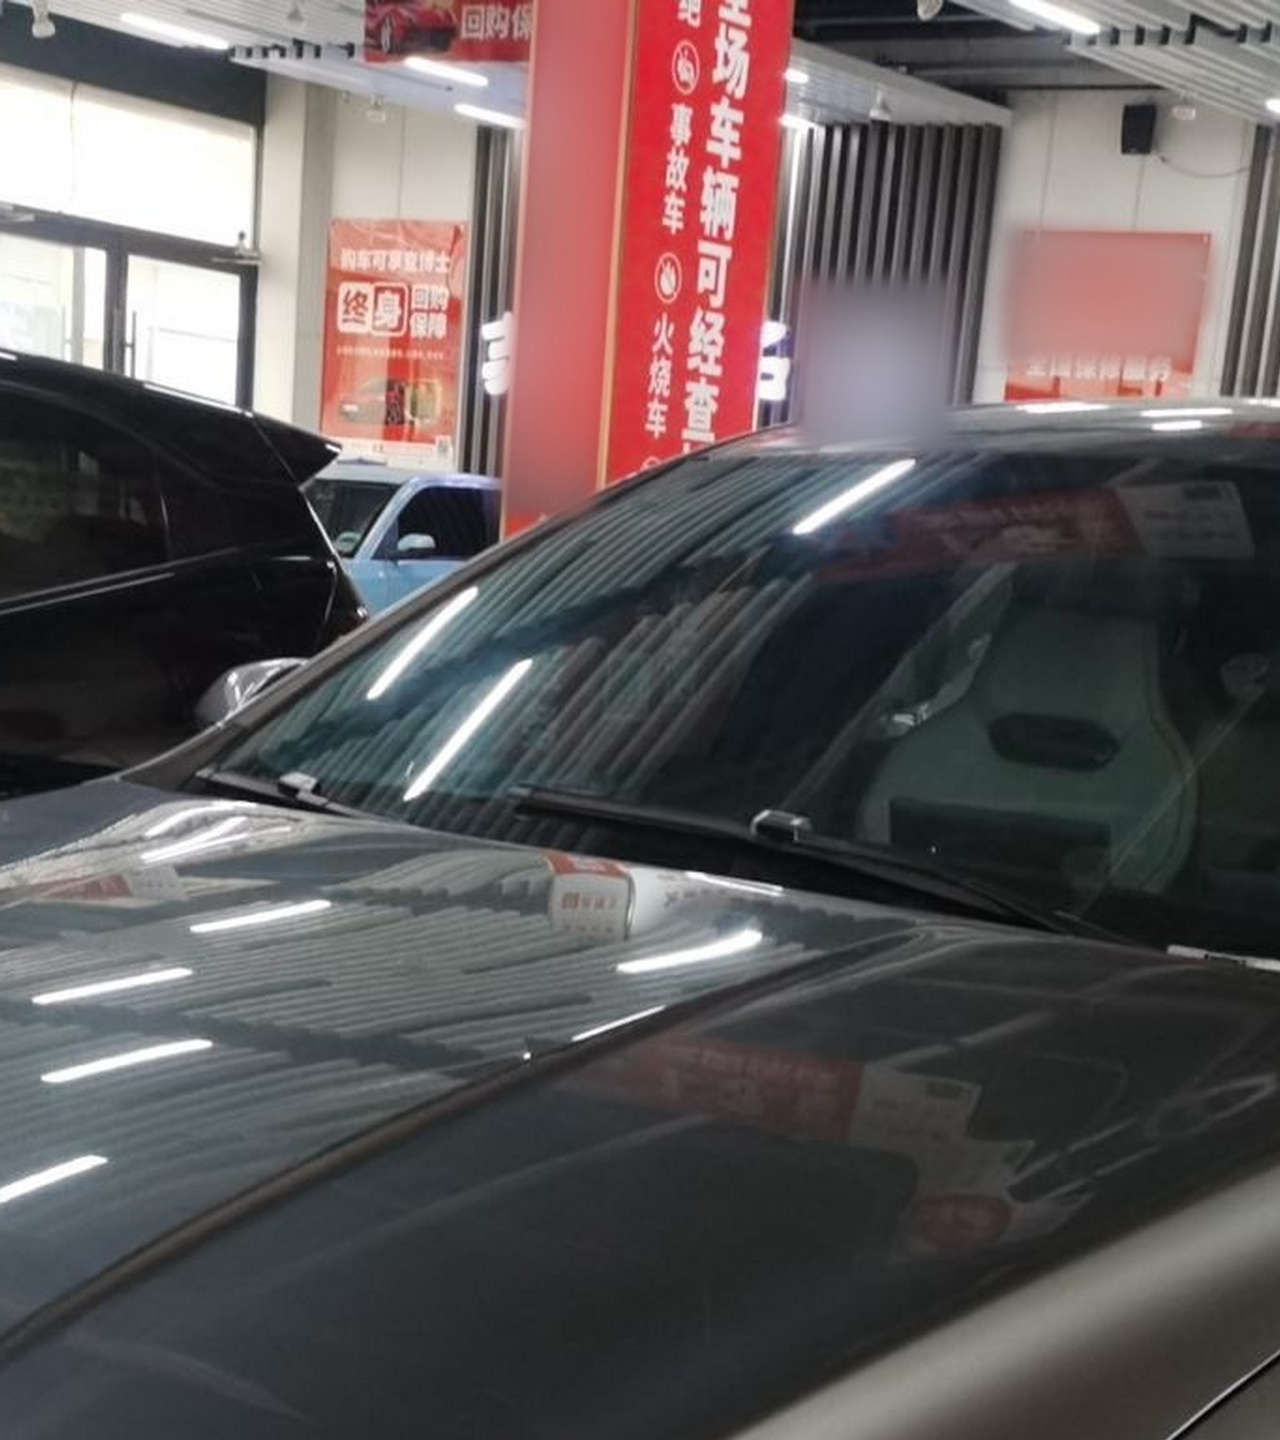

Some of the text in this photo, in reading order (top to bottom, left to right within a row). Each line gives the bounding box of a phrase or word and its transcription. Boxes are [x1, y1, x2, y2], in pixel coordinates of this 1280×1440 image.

[662, 102, 693, 235] 事故车
[681, 0, 752, 454] 场车辆可经查
[644, 311, 675, 439] 火烧车
